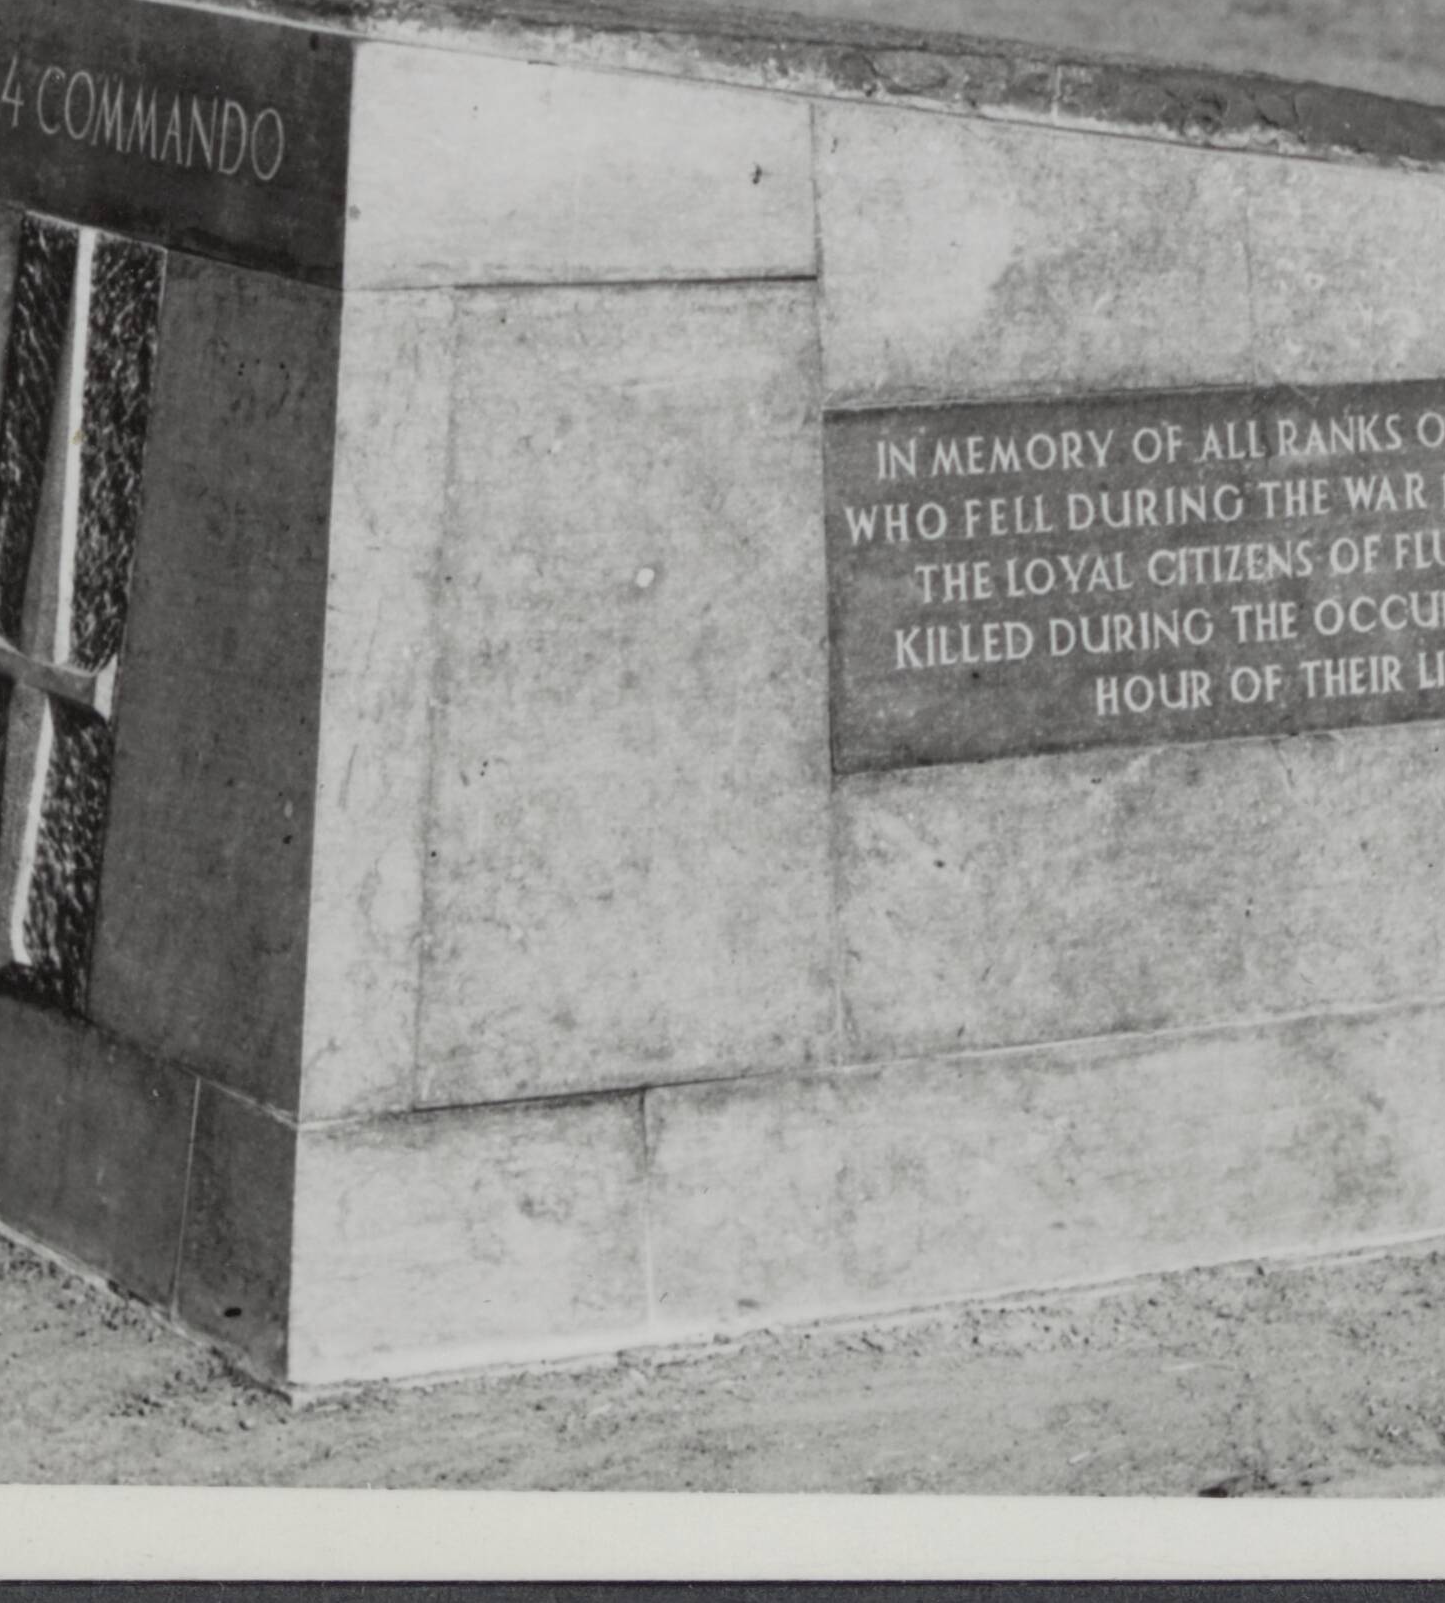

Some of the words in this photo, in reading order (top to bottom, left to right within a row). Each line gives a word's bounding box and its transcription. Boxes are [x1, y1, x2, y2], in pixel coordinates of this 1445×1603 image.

[37, 67, 284, 181] COMMANDO
[877, 437, 917, 480] IN
[931, 429, 1114, 477] MEMORY
[1132, 425, 1182, 464] OF
[1198, 421, 1265, 462] ALL
[1278, 414, 1403, 456] RANKS
[845, 502, 947, 545] WHO
[964, 495, 1053, 538] FELL
[1068, 484, 1243, 531] DURING
[1258, 479, 1330, 519] THE
[1343, 472, 1426, 512] WAR
[914, 561, 992, 604] THE
[1006, 552, 1133, 597] LOYAL
[1148, 540, 1313, 587] CITIZENS
[1330, 534, 1381, 575] OF
[895, 621, 1034, 670] KILLED
[1049, 608, 1214, 657] DURING
[1231, 601, 1298, 643] THE
[1096, 670, 1212, 716] HOUR
[1231, 665, 1282, 703] OF
[1300, 655, 1403, 698] THEIR
